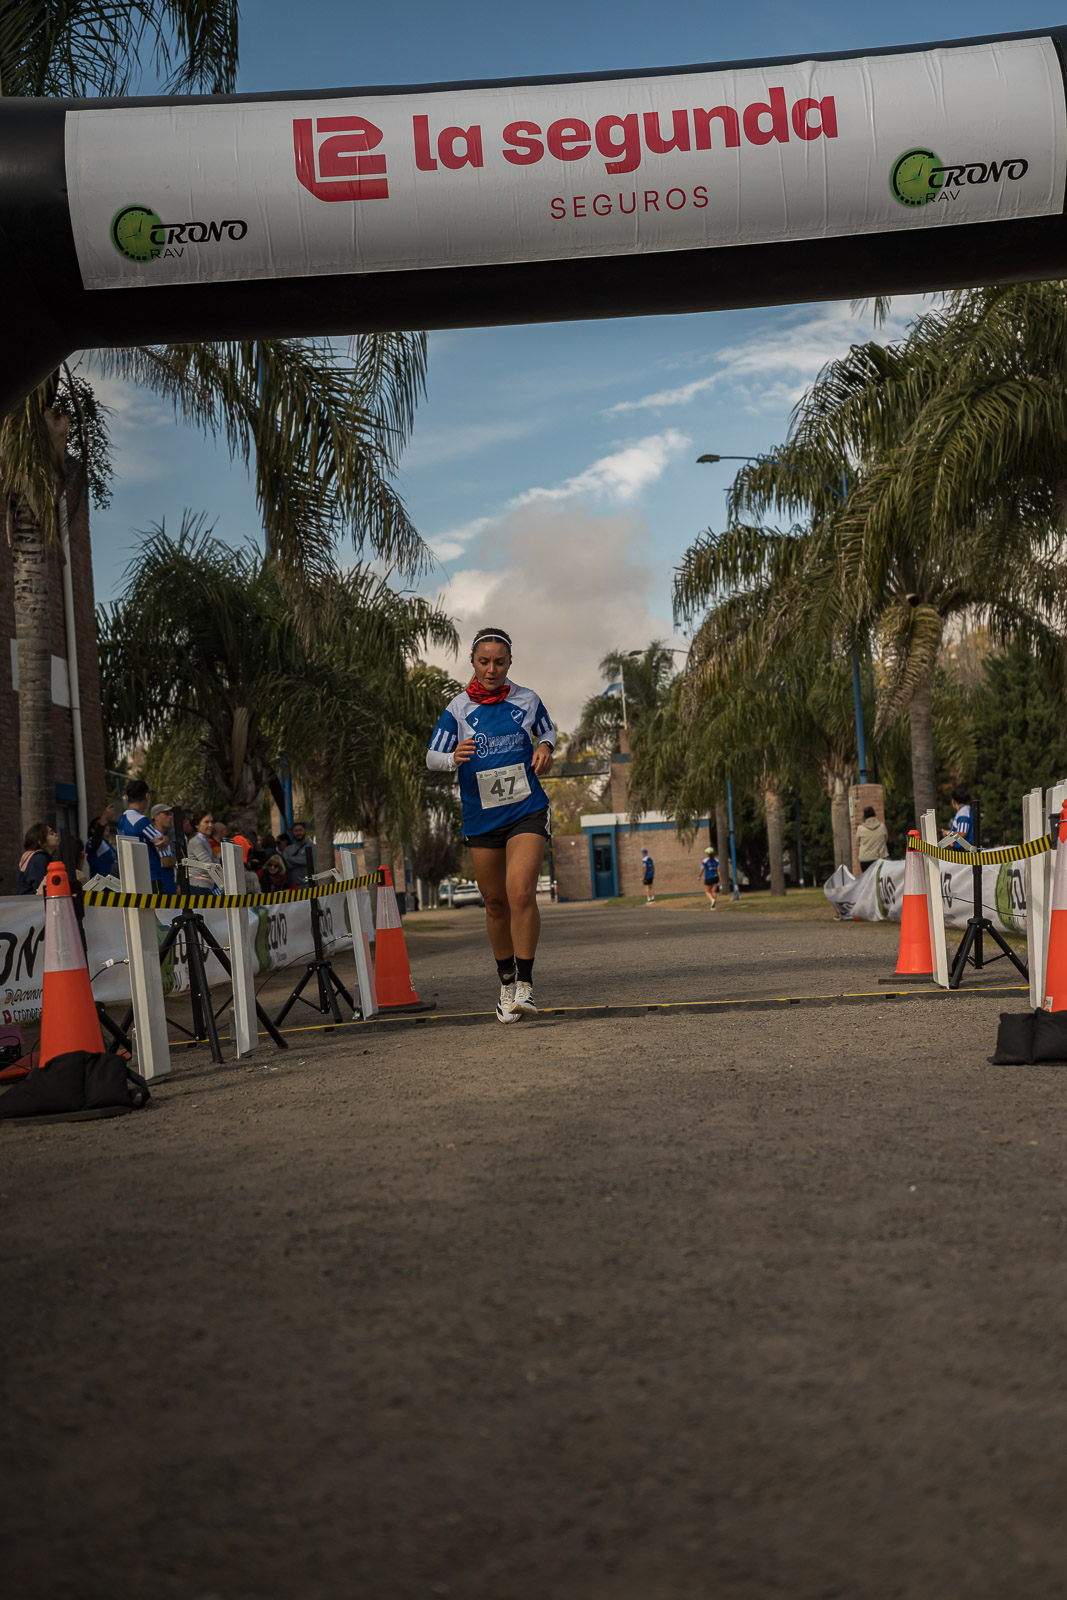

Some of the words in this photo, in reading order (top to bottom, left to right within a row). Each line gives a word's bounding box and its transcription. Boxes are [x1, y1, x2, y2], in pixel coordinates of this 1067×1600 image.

[412, 114, 483, 172] la
[502, 86, 838, 175] segunda
[928, 159, 1029, 188] CRONO
[550, 186, 709, 219] SEGUROS
[925, 190, 960, 203] RAV
[150, 219, 248, 245] CRONO
[150, 247, 184, 259] RAV
[475, 733, 489, 758] 3
[490, 776, 516, 797] 47
